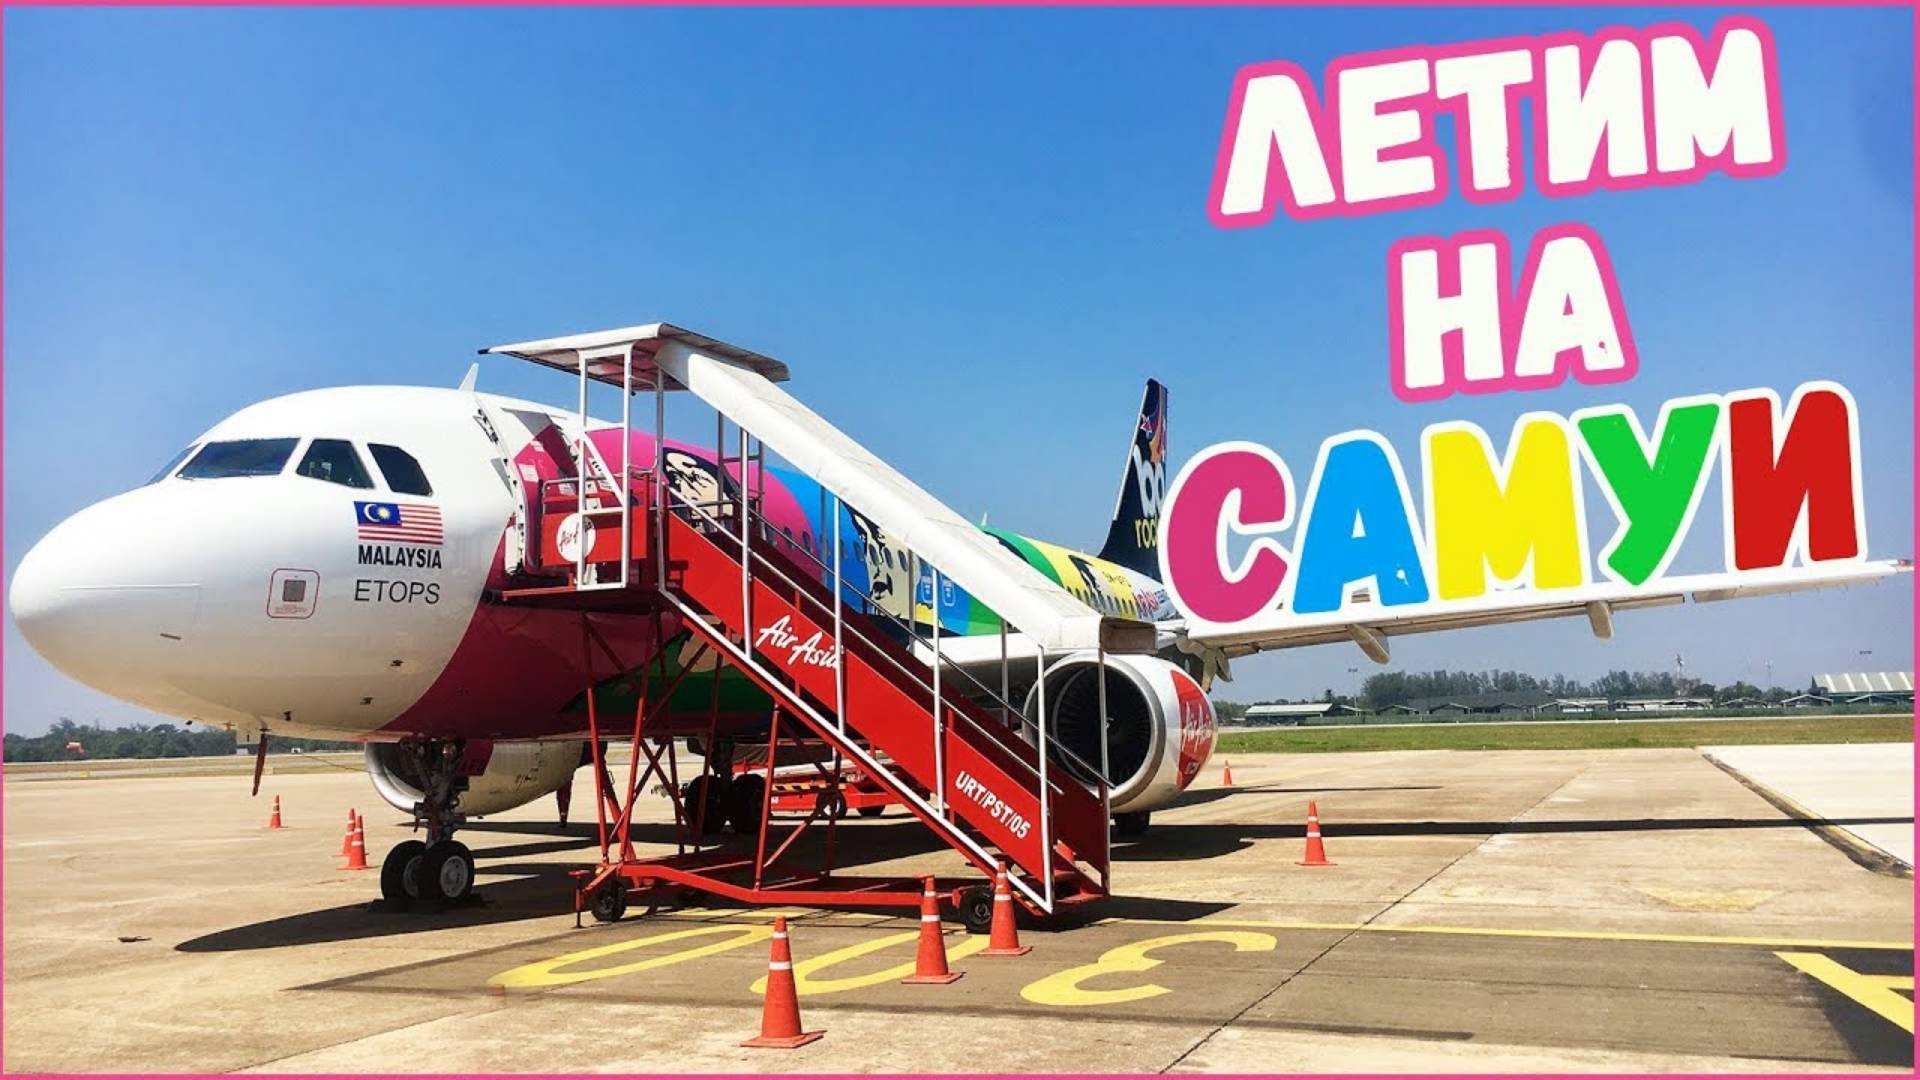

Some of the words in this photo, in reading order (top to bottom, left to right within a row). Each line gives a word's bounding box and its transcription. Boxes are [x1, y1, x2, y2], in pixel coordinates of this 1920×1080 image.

[358, 544, 442, 569] MALAYSIA
[354, 578, 441, 605] ETOPS
[955, 770, 1032, 840] URT/PST/05
